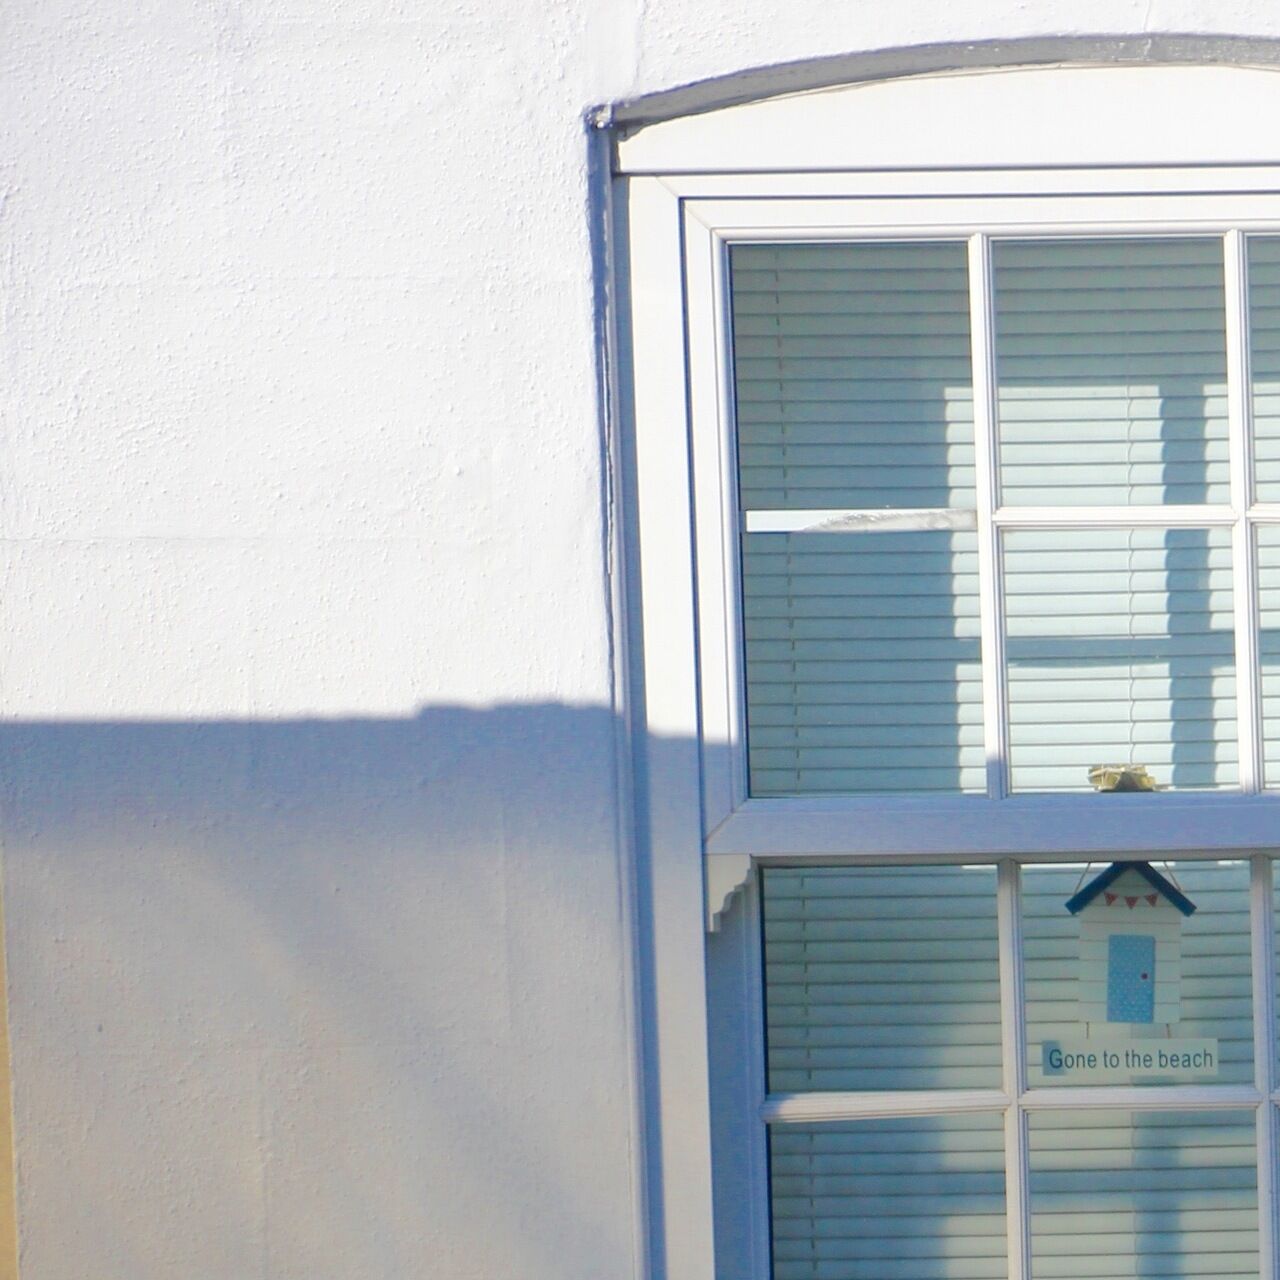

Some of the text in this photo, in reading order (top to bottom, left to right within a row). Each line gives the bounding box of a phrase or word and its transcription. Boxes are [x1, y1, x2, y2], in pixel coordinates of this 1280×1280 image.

[1048, 1048, 1213, 1069] Gone to the beach
